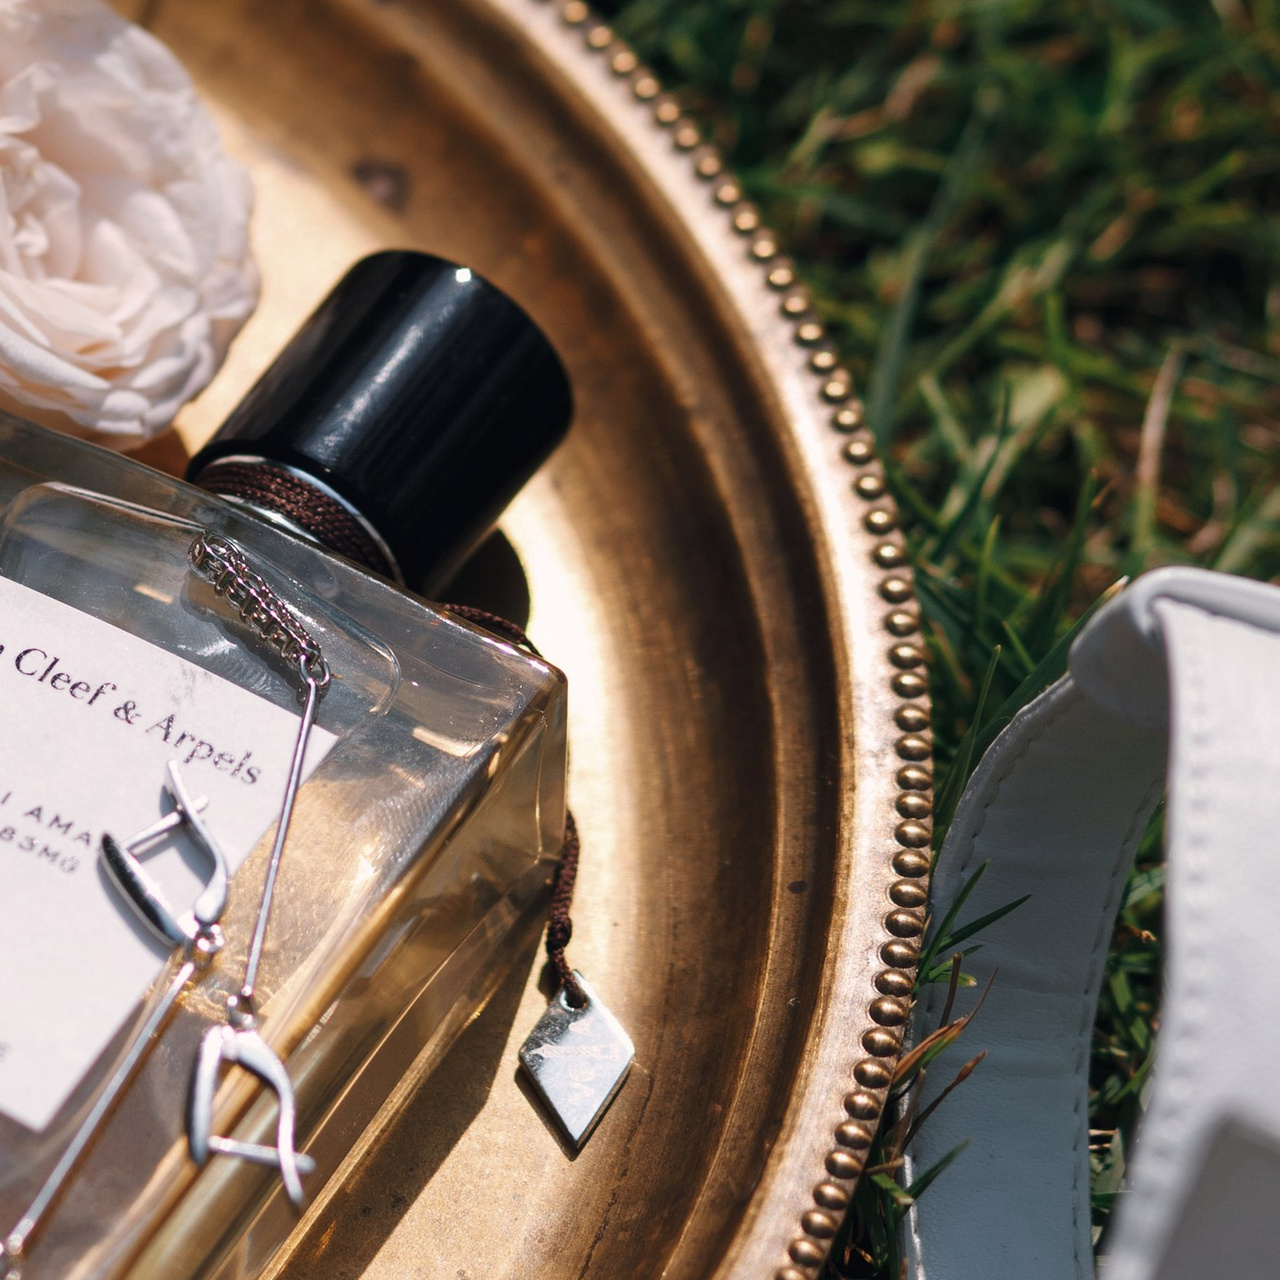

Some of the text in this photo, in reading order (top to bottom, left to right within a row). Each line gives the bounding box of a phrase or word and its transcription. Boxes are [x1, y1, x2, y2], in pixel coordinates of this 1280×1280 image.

[14, 647, 118, 706] Cleef
[113, 699, 143, 726] &
[145, 713, 263, 786] Arpels
[23, 806, 92, 847] AMA
